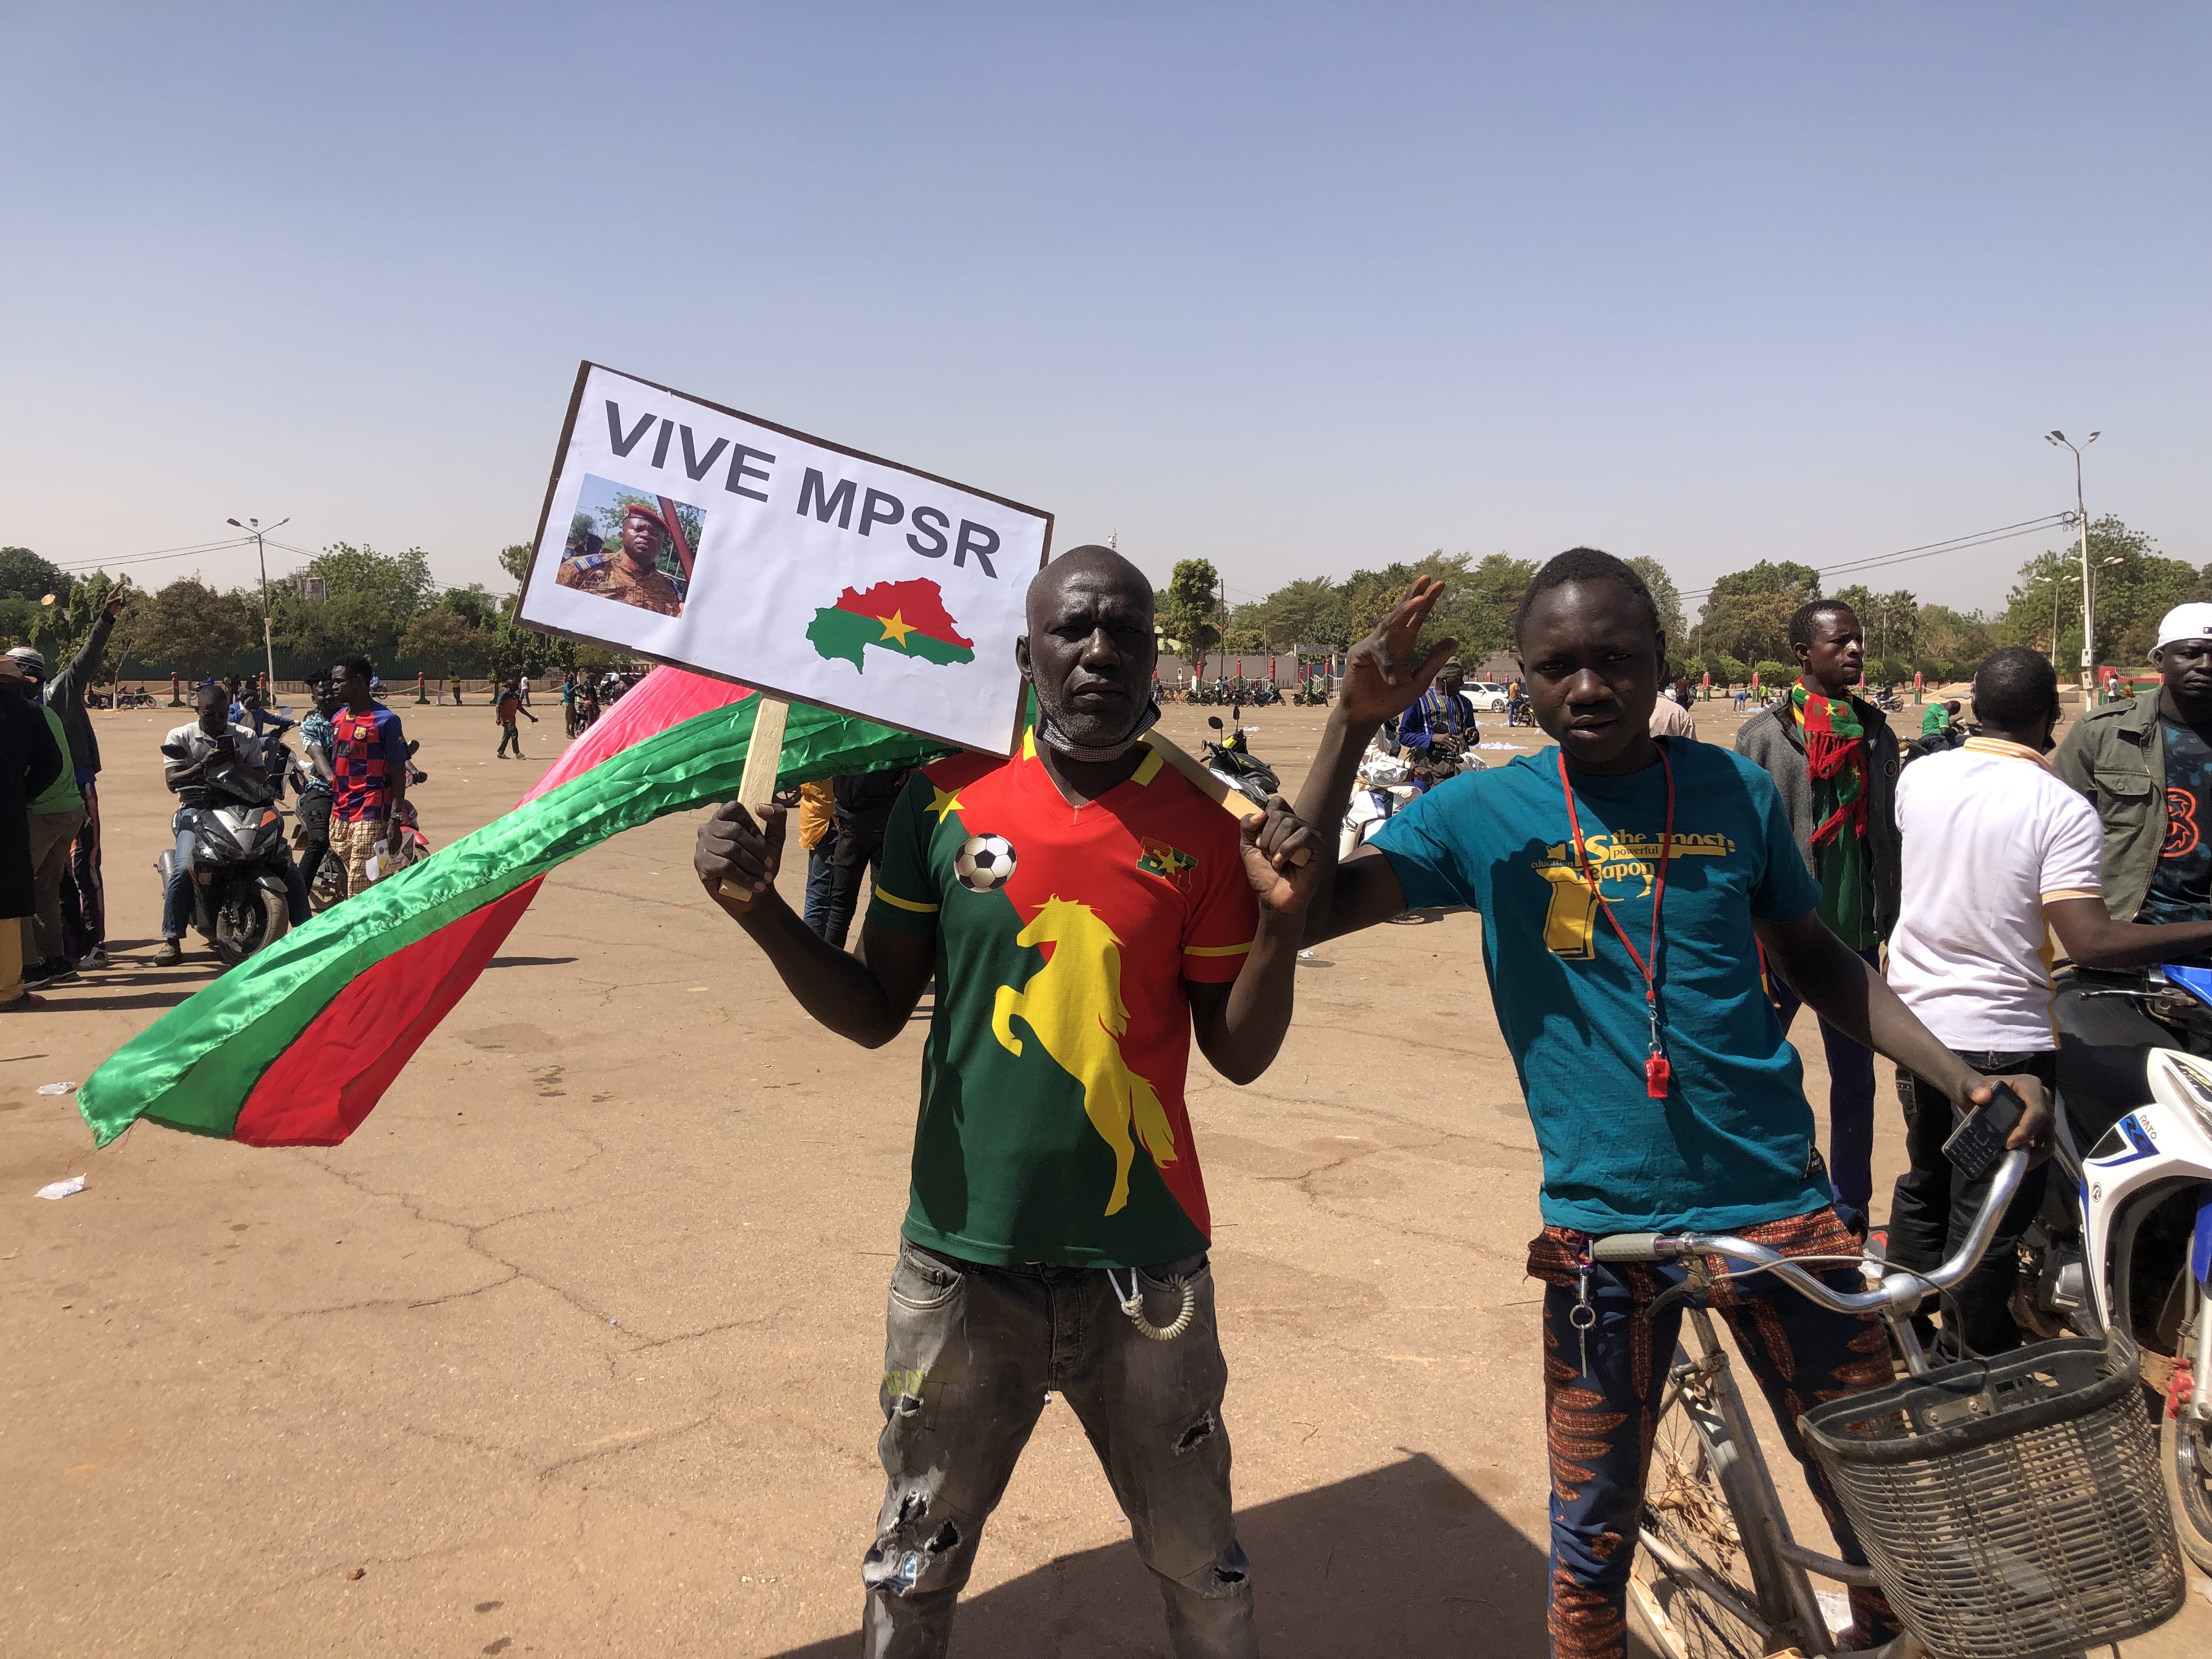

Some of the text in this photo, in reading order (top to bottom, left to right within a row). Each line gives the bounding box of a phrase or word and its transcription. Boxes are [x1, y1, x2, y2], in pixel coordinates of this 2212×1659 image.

[605, 399, 1001, 579] VIVE MPSR
[1568, 828, 1610, 867] is
[1611, 829, 1726, 846] the most
[1613, 845, 1660, 859] powerful
[1531, 859, 1574, 868] education
[2138, 1114, 2157, 1140] RATO
